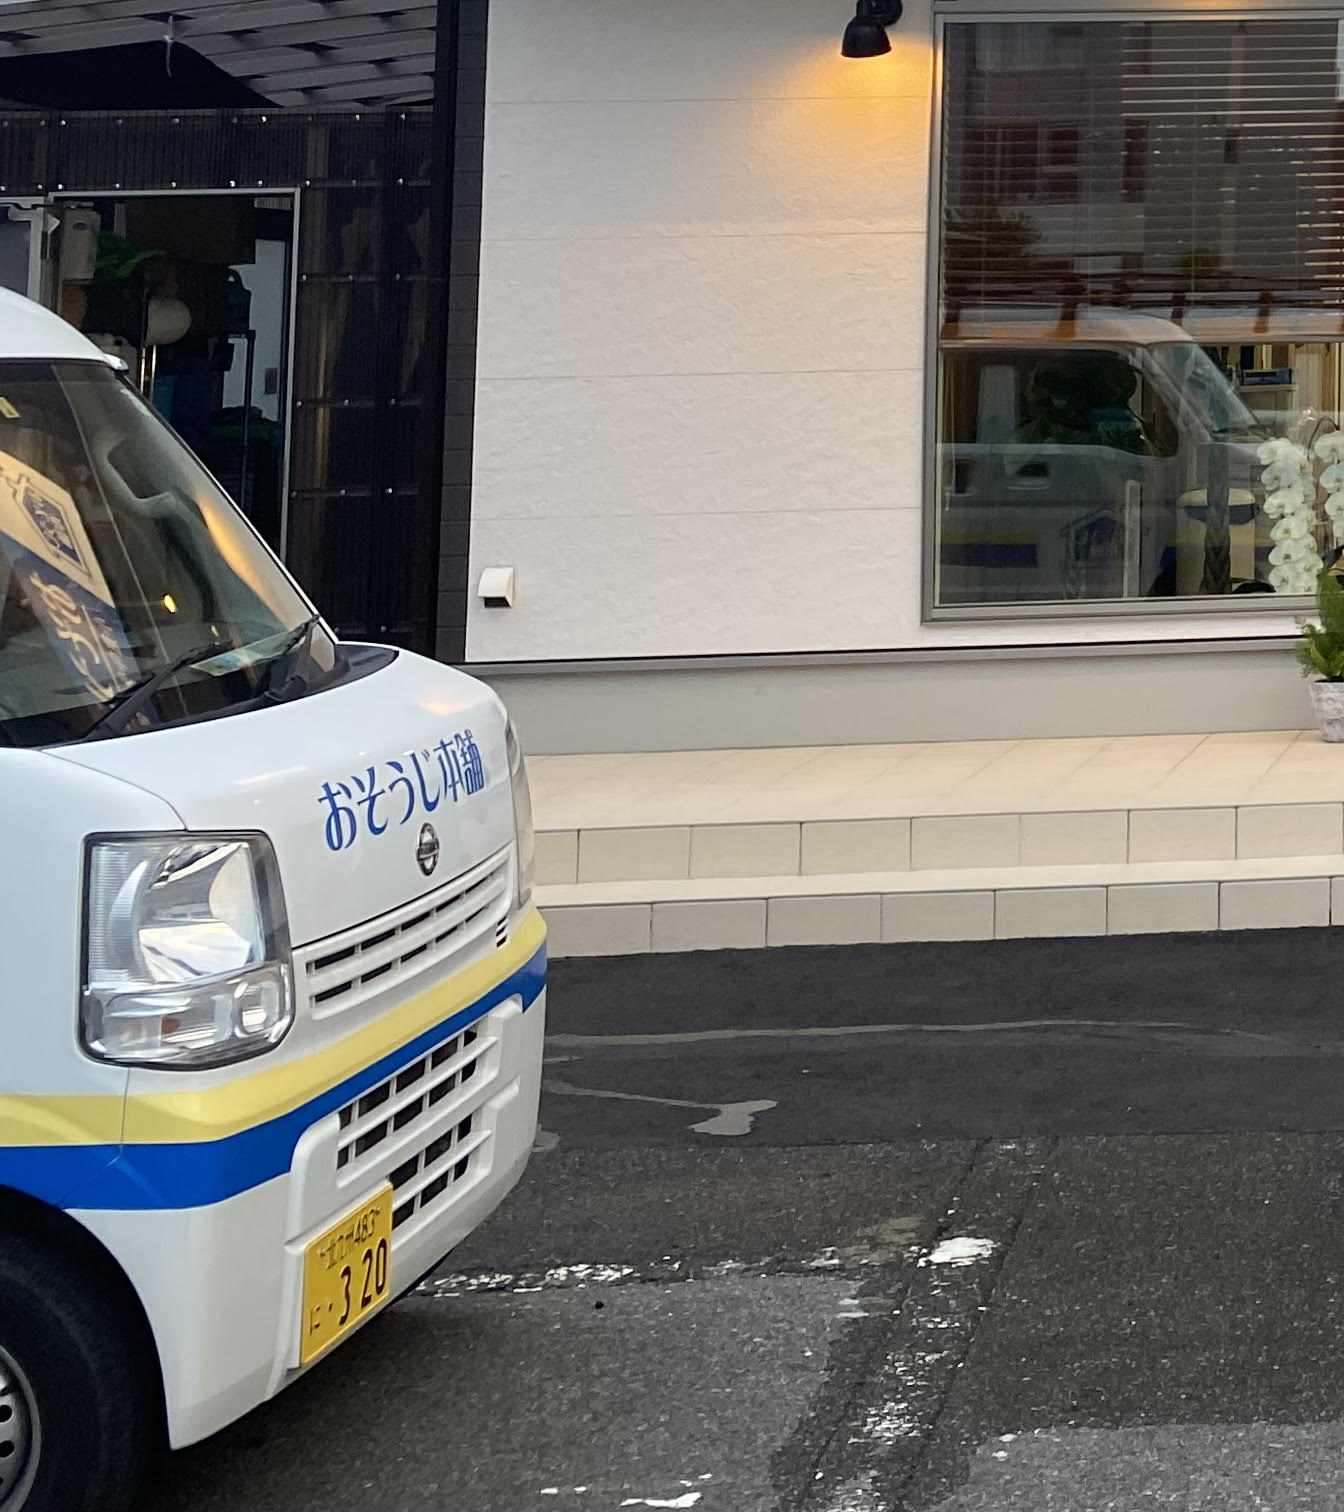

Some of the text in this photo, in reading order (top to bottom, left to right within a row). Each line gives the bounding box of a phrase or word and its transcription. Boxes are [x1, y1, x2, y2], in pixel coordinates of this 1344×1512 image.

[318, 729, 485, 851] おそうじ本舗
